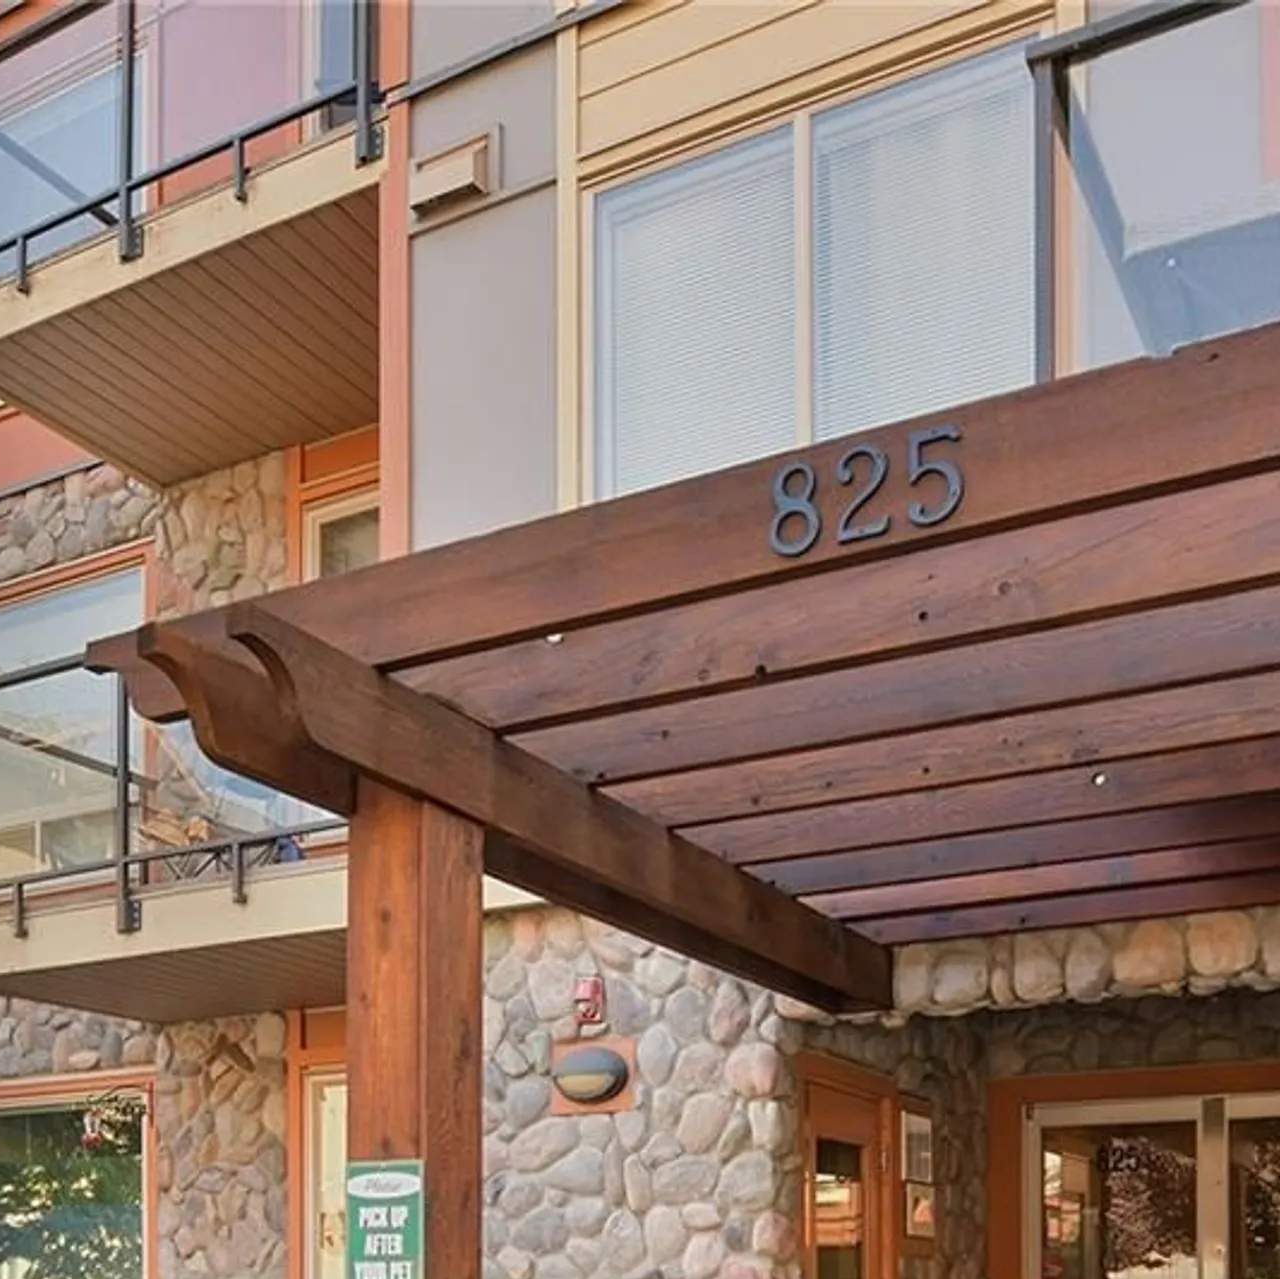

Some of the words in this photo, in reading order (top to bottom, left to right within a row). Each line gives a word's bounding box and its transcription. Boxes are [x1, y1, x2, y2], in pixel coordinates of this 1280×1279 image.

[770, 422, 965, 557] 825
[359, 1207, 388, 1228] PICK
[391, 1206, 408, 1228] UP
[365, 1233, 403, 1255] AFTER
